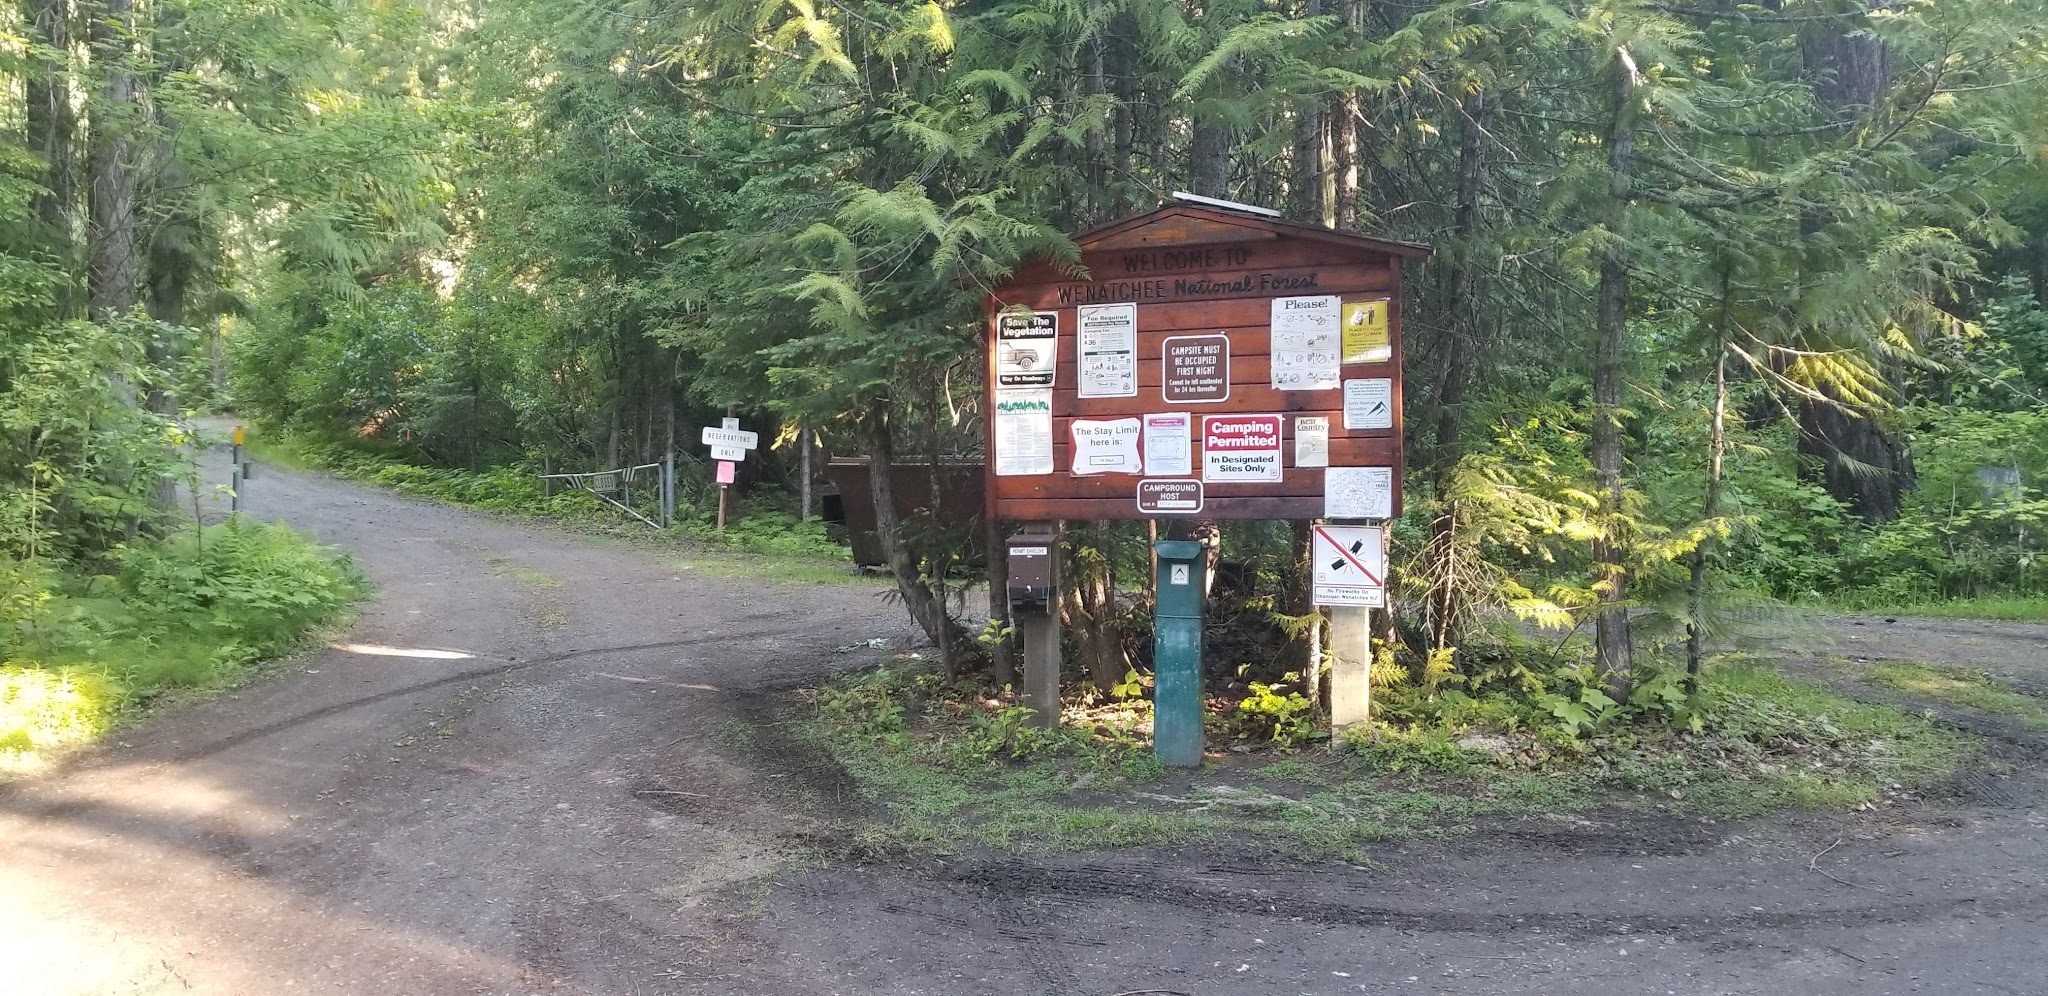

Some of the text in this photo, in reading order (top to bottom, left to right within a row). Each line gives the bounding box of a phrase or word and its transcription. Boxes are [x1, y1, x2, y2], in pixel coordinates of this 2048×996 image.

[1124, 249, 1247, 272] WELCOME TO
[1058, 273, 1318, 304] WENATCHEE National Forest
[1285, 298, 1328, 310] Please!
[1007, 317, 1050, 326] Save The
[1003, 326, 1053, 337] Vegetation
[1171, 345, 1221, 355] CAMPSITE MUST
[1175, 356, 1217, 366] BE OCCUPIED
[1177, 366, 1215, 376] FIRST NIGHT
[1076, 425, 1138, 437] The Stay Limit
[1212, 421, 1273, 434] Camping
[1297, 424, 1326, 432] Country
[708, 432, 750, 443] RESERVATIONS
[1208, 435, 1276, 447] Permitted
[720, 449, 735, 457] ONLY
[1222, 455, 1274, 464] Designated
[1220, 464, 1265, 473] Sites Only
